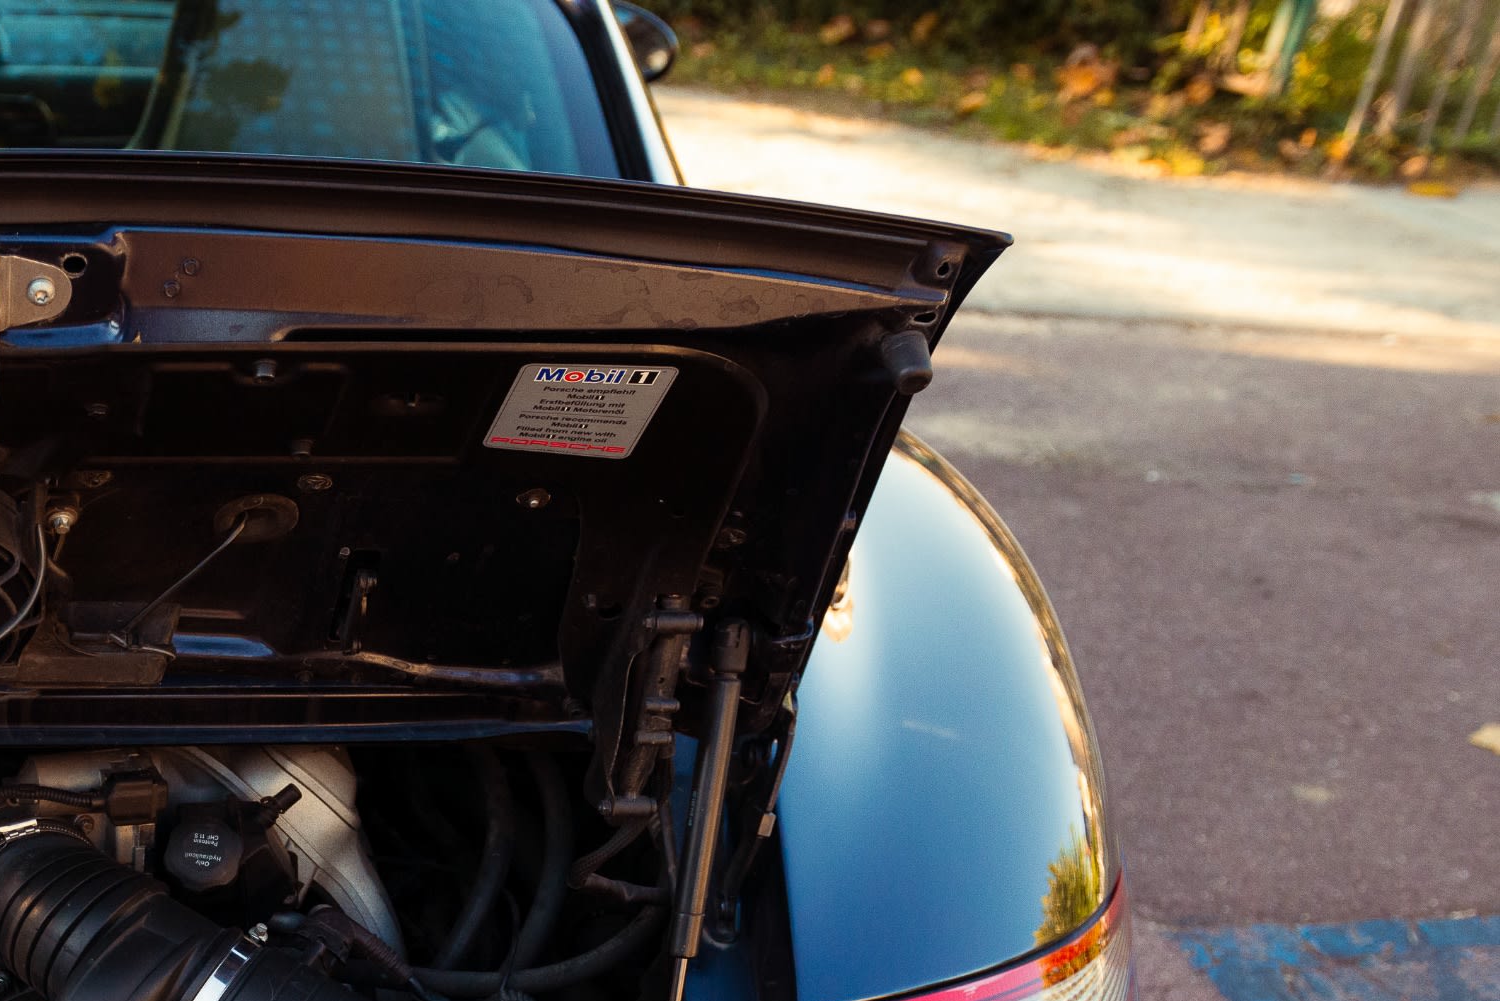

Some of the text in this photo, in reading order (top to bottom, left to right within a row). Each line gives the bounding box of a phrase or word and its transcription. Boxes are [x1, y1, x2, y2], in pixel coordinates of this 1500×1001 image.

[534, 367, 660, 385] Mobil 1
[543, 386, 636, 396] Porsche empfiehlt
[518, 413, 628, 425] Porsche recommends
[545, 426, 569, 434] from
[595, 430, 617, 438] with
[490, 436, 626, 454] PORSCHE
[558, 435, 591, 443] engine
